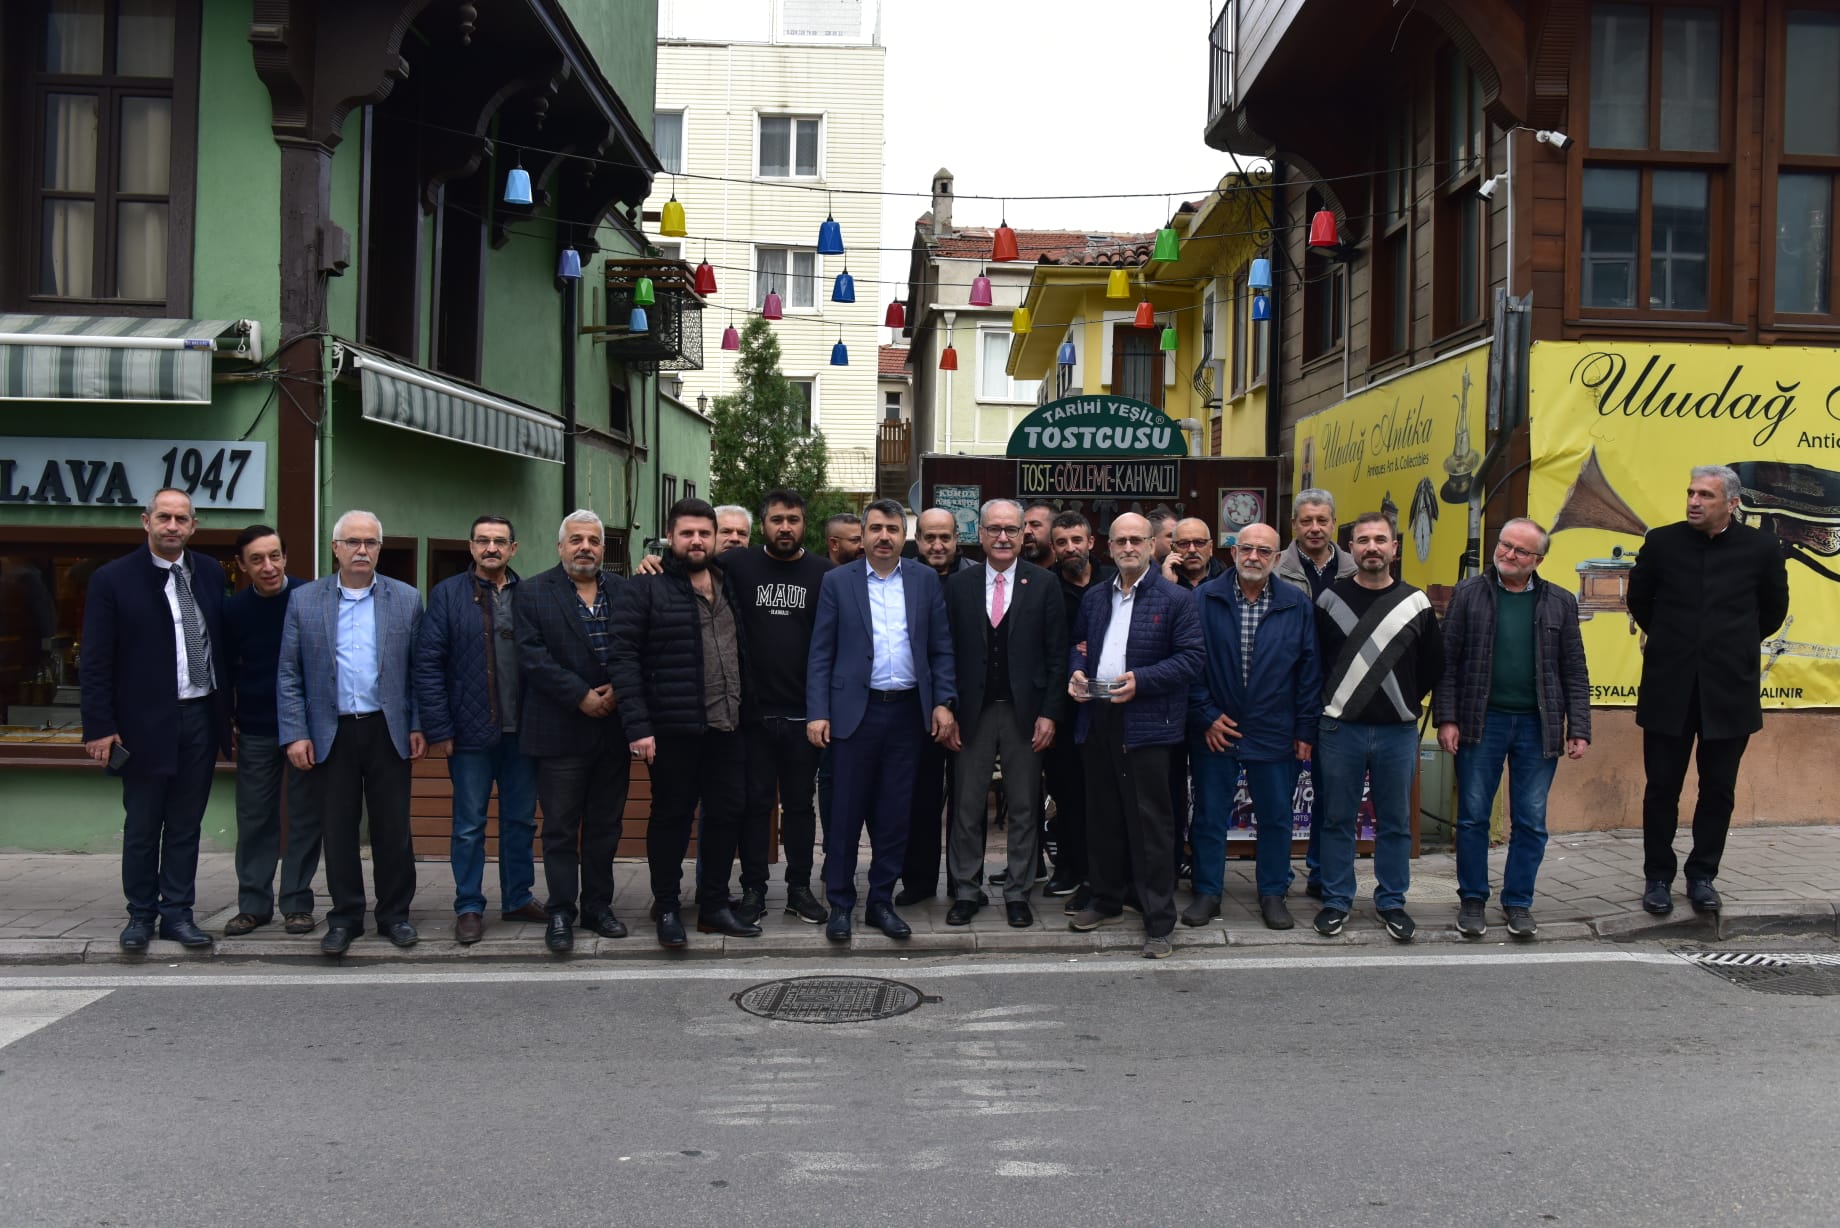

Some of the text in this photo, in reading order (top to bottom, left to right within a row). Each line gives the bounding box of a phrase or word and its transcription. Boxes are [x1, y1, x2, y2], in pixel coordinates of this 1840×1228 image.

[1569, 351, 1801, 447] Uludağ
[1042, 399, 1155, 426] TARİHİ YEŞİL
[1024, 426, 1172, 449] TOSTCUSU
[162, 446, 252, 501] 1947
[756, 583, 807, 609] MAUI
[1760, 687, 1803, 699] ALINIR
